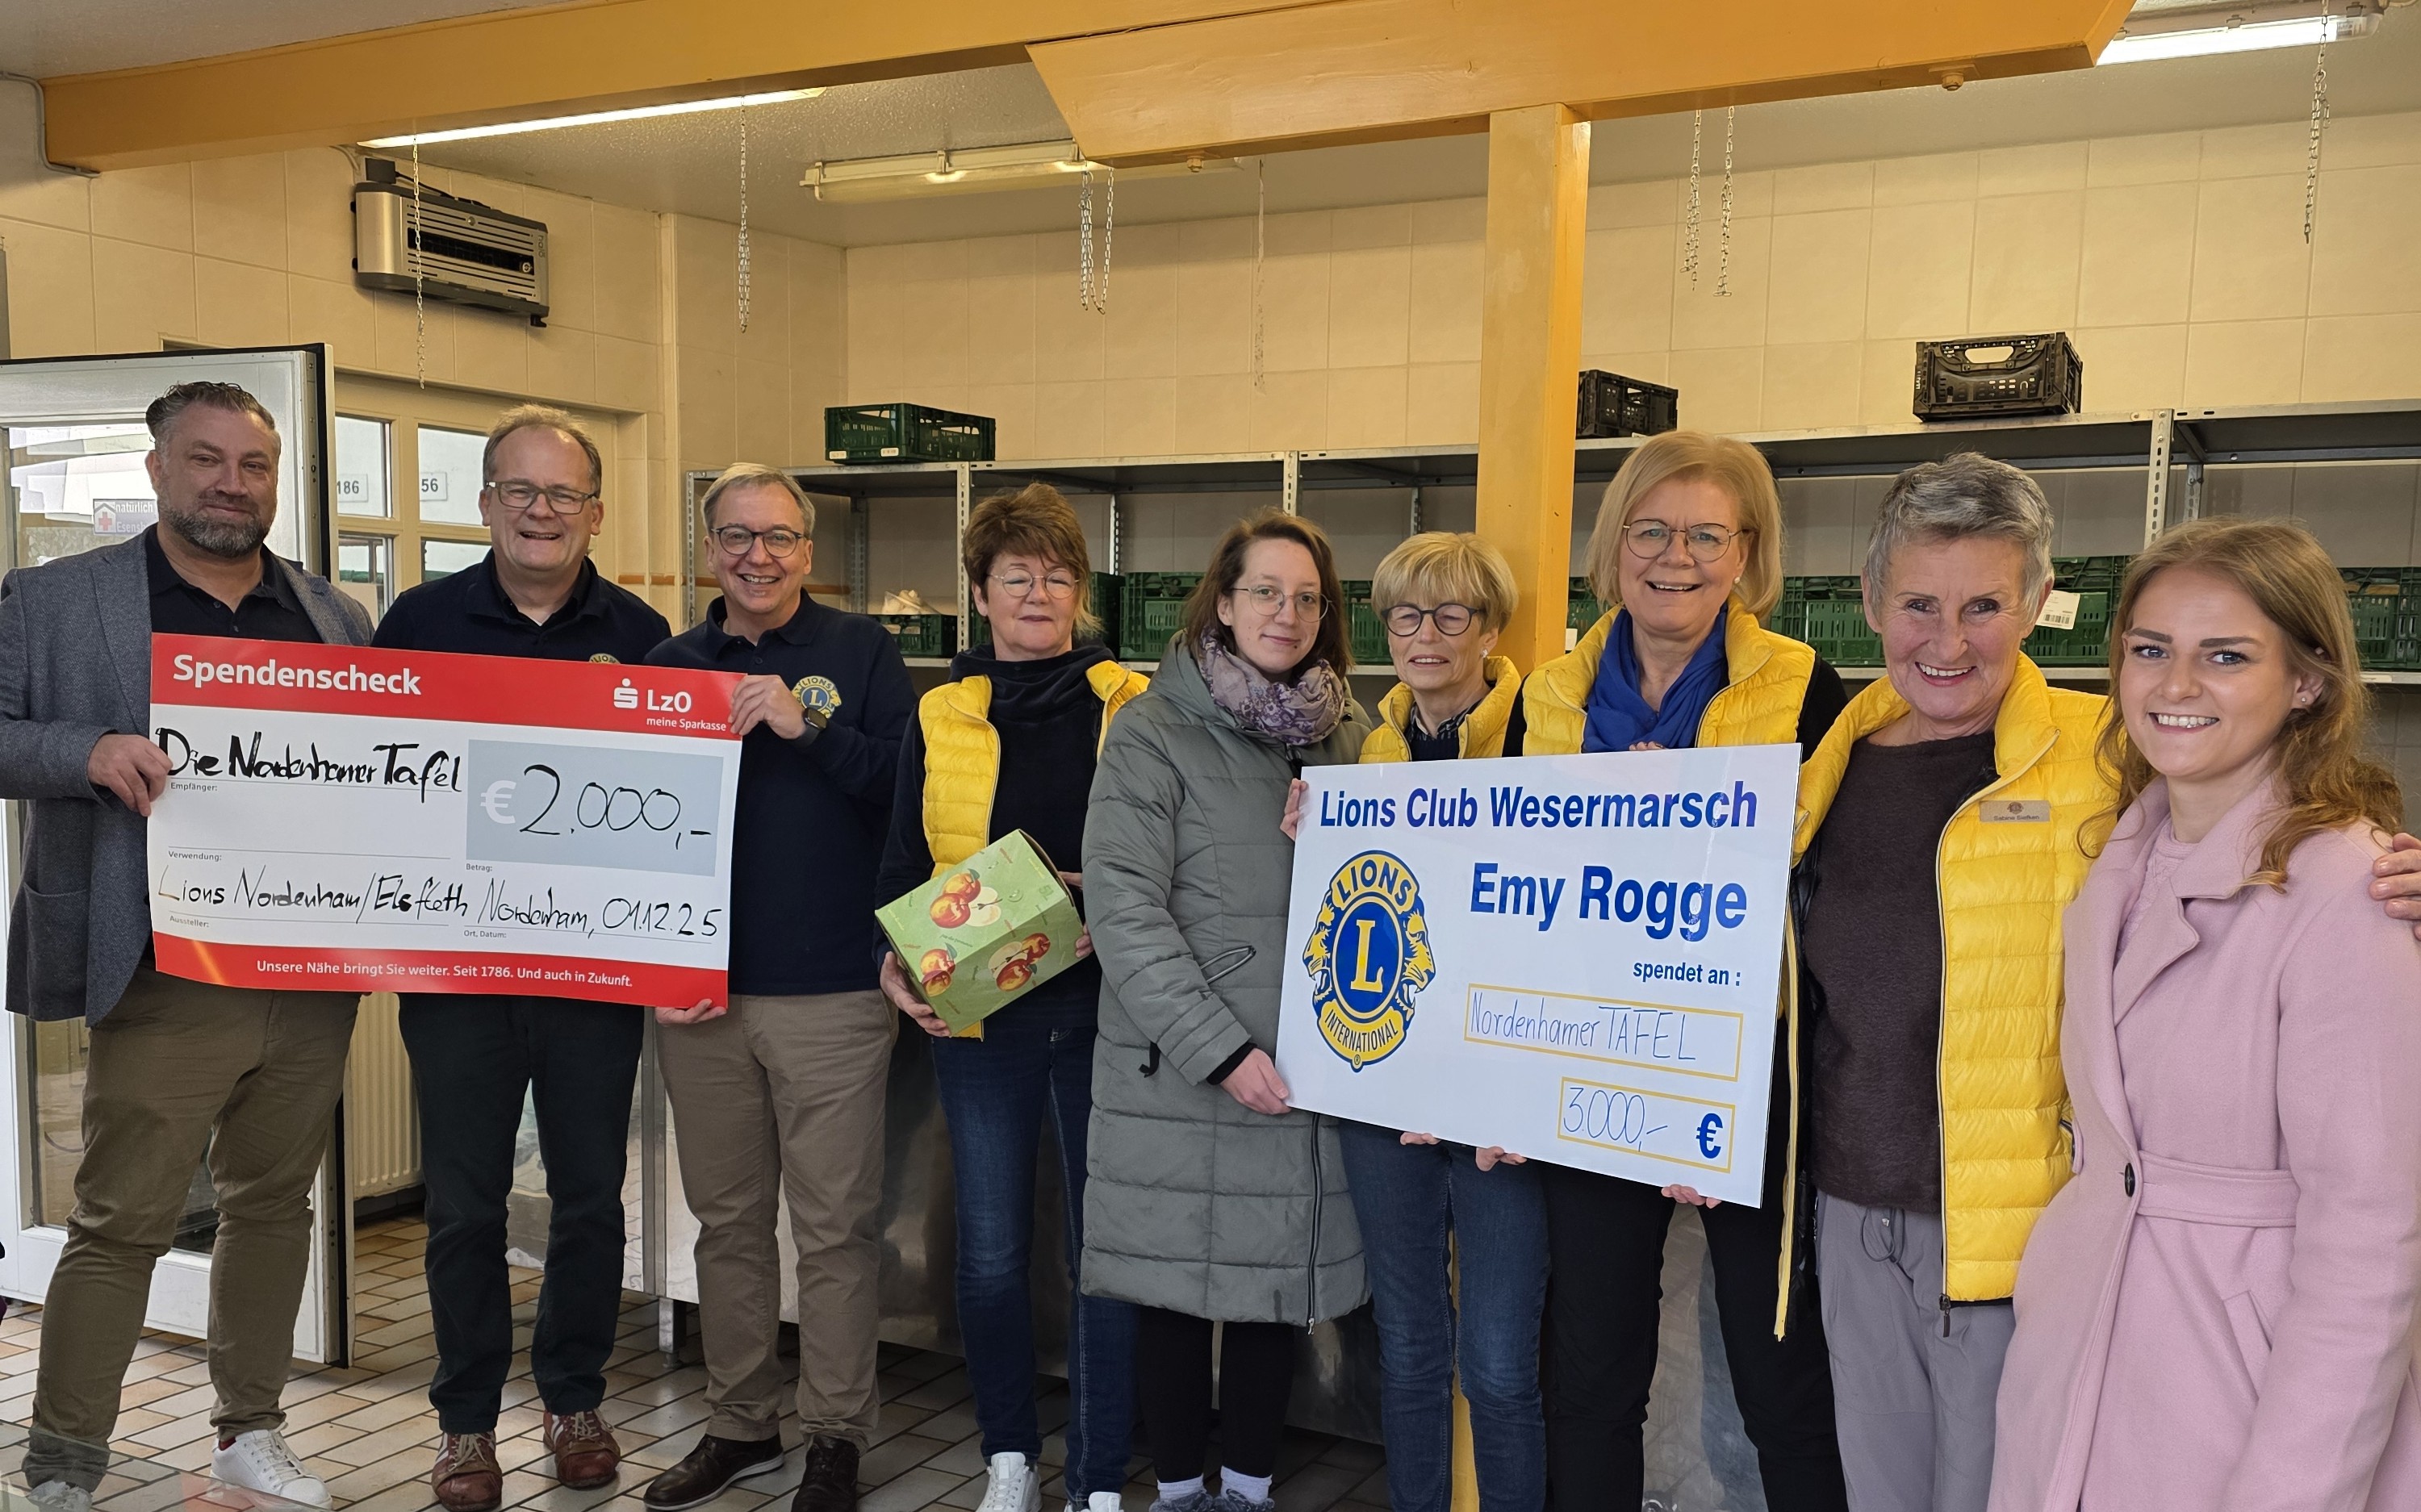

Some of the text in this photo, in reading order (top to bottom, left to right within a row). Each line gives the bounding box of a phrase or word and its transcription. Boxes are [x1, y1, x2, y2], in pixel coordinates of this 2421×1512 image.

[115, 501, 153, 513] natürlich
[173, 654, 421, 695] Spendenscheck
[801, 677, 832, 689] LIONS
[647, 689, 692, 713] LzO
[809, 689, 822, 707] L
[646, 717, 726, 732] meine Sparkasse
[155, 727, 223, 777] Die
[373, 742, 462, 804] Tafel
[169, 781, 218, 792] Empfänger:
[1320, 779, 1758, 829] Lions Club Wesermarsch
[168, 850, 222, 862] Verwendung:
[466, 863, 493, 873] Betrag:
[158, 864, 225, 904] Lions
[1336, 858, 1411, 907] LIONS
[1470, 862, 1748, 941] Emy Rogge
[169, 915, 209, 928] Aussteller:
[463, 929, 507, 939] Ort, Datum:
[1350, 918, 1384, 993] L
[257, 960, 633, 988] Unsere Nähe bringt Sie weiter. Seit 1786. Und auch in Zukunft.
[1633, 961, 1704, 984] spendet
[1708, 969, 1730, 985] an
[1324, 1009, 1399, 1054] INTERNATIONAL
[1470, 992, 1696, 1061] Nordenhamer TAFEL
[1696, 1113, 1724, 1159] €
